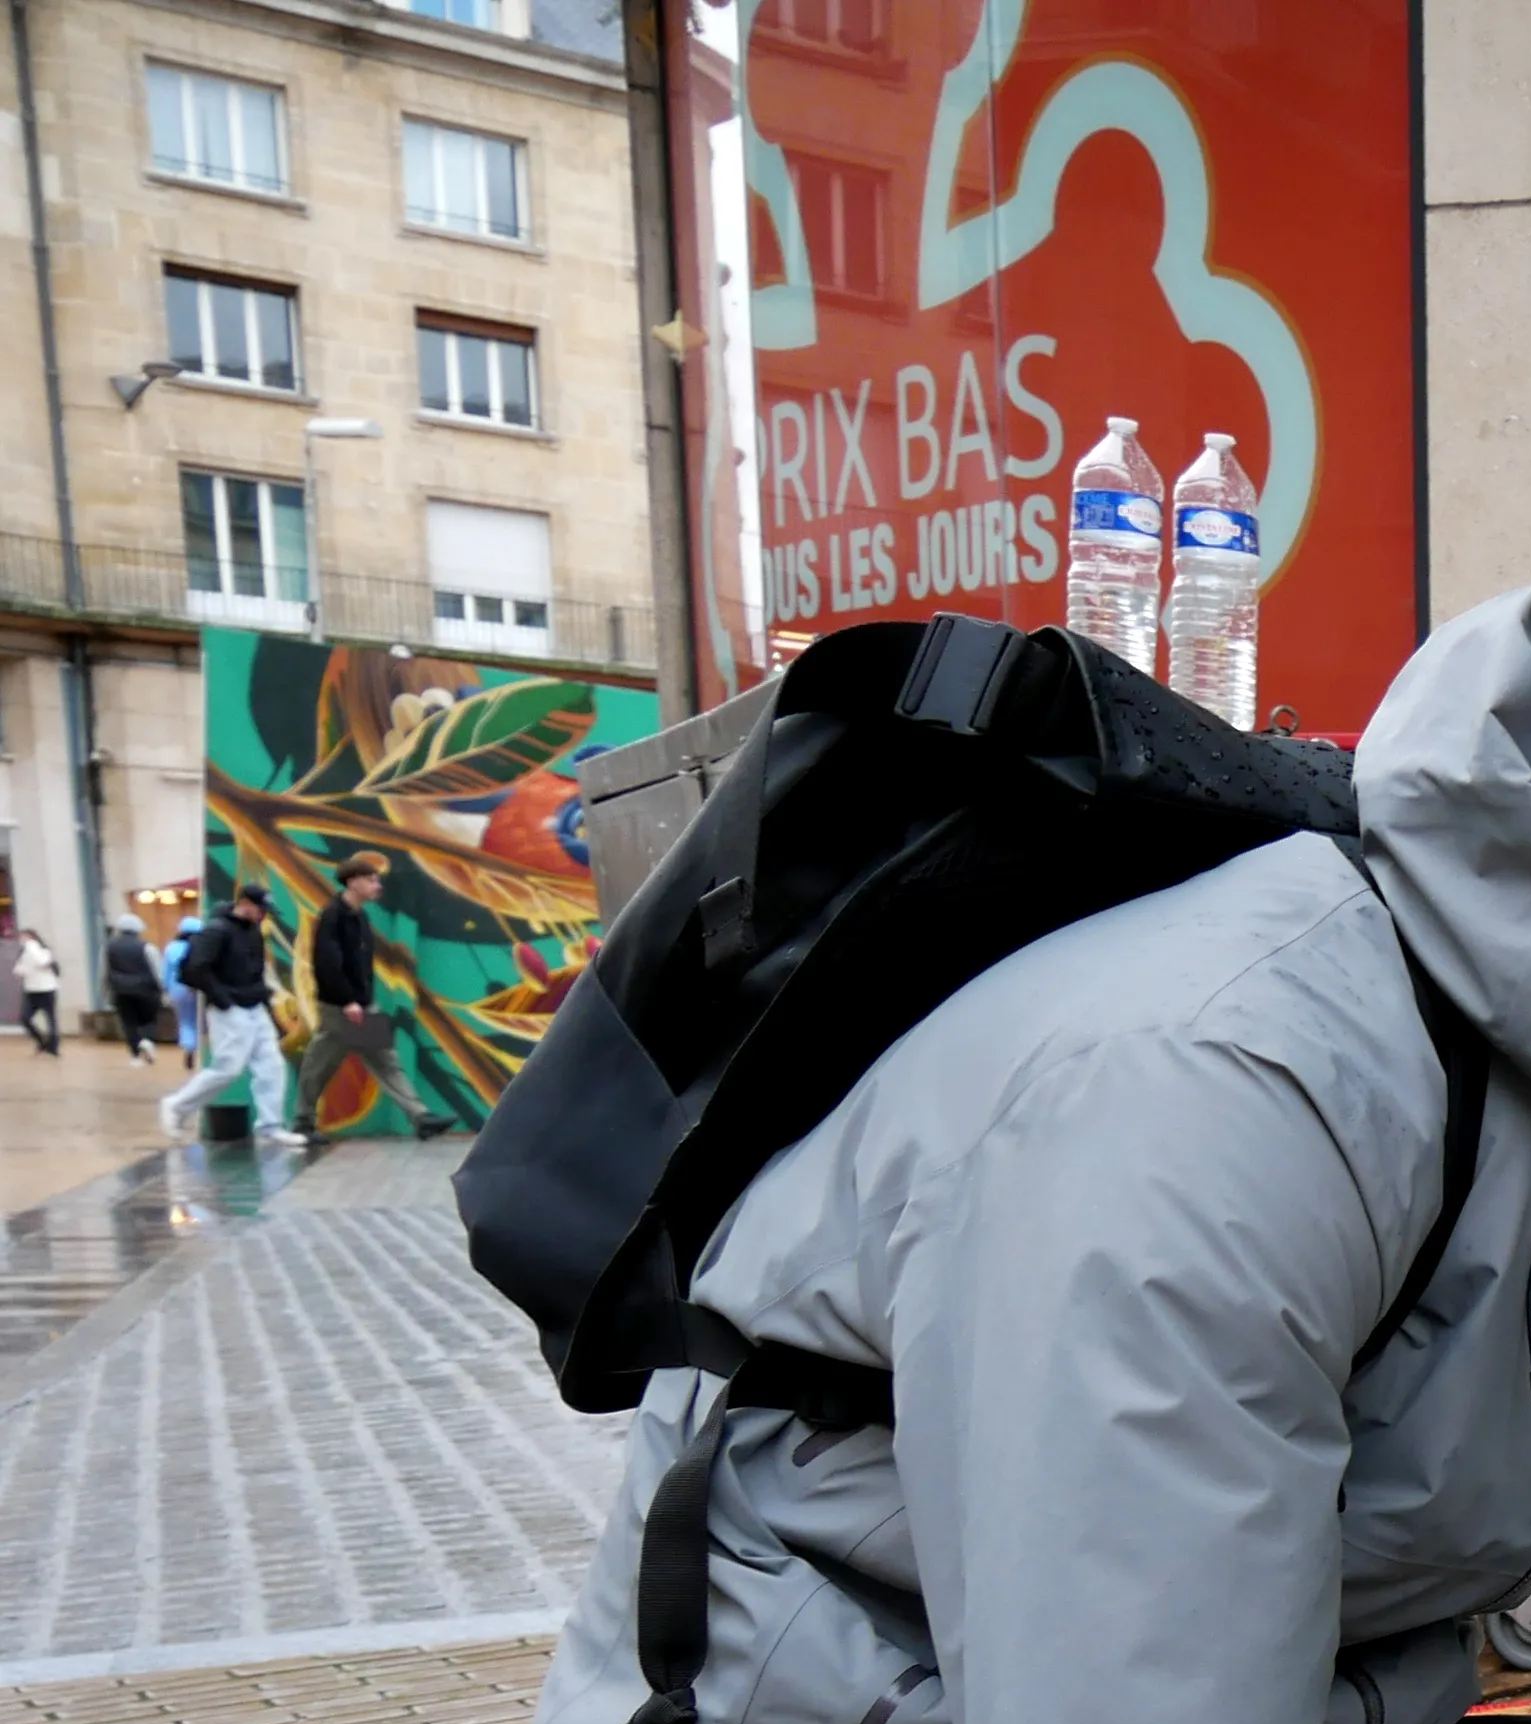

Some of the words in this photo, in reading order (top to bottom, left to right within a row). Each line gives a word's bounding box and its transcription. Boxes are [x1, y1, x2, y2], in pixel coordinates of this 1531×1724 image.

[756, 378, 876, 528] RIX
[897, 334, 1063, 499] BAS
[829, 523, 897, 612] LES
[907, 494, 1060, 600] JOURS
